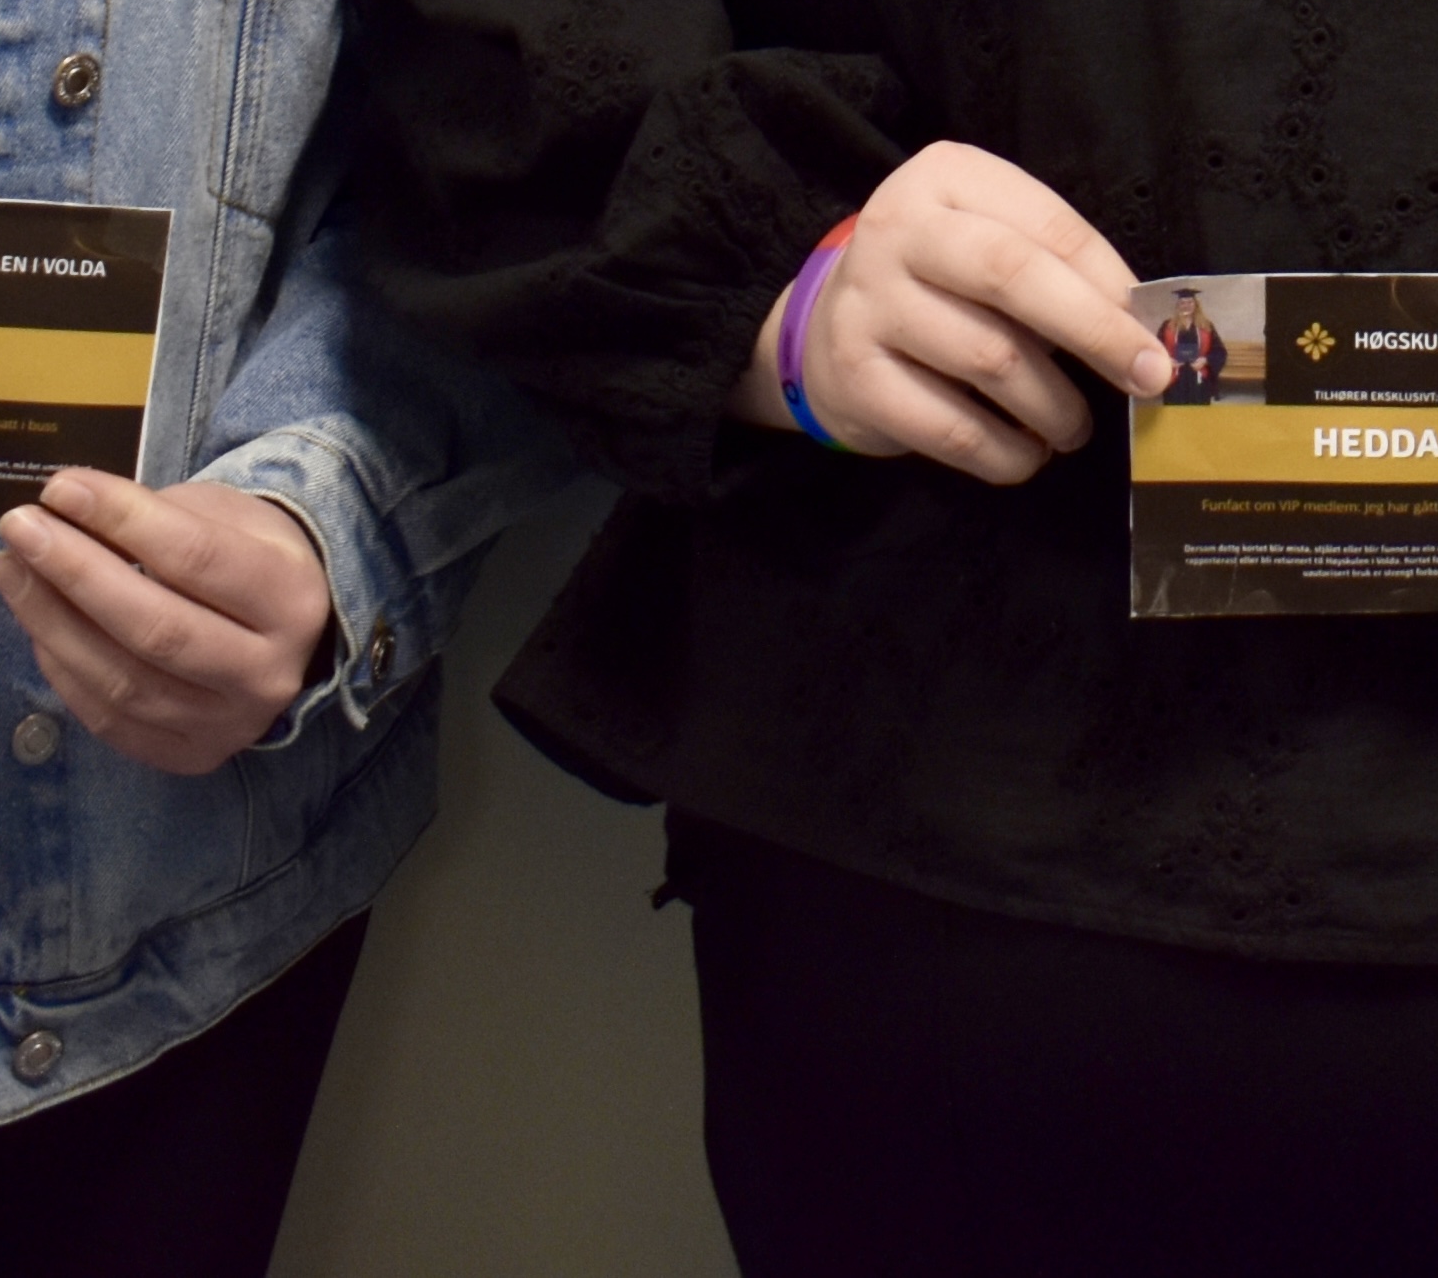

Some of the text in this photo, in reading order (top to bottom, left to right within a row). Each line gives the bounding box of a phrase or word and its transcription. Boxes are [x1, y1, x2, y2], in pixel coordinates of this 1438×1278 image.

[31, 256, 39, 274] I
[42, 257, 106, 277] VOLDA
[1314, 390, 1438, 403] TILHØRER EKSKLUSIVT:
[26, 419, 58, 433] buss
[1201, 498, 1251, 513] Funfact
[1252, 501, 1276, 512] om
[1278, 499, 1301, 512] VIP
[1386, 501, 1409, 514] har
[1412, 500, 1438, 516] gått
